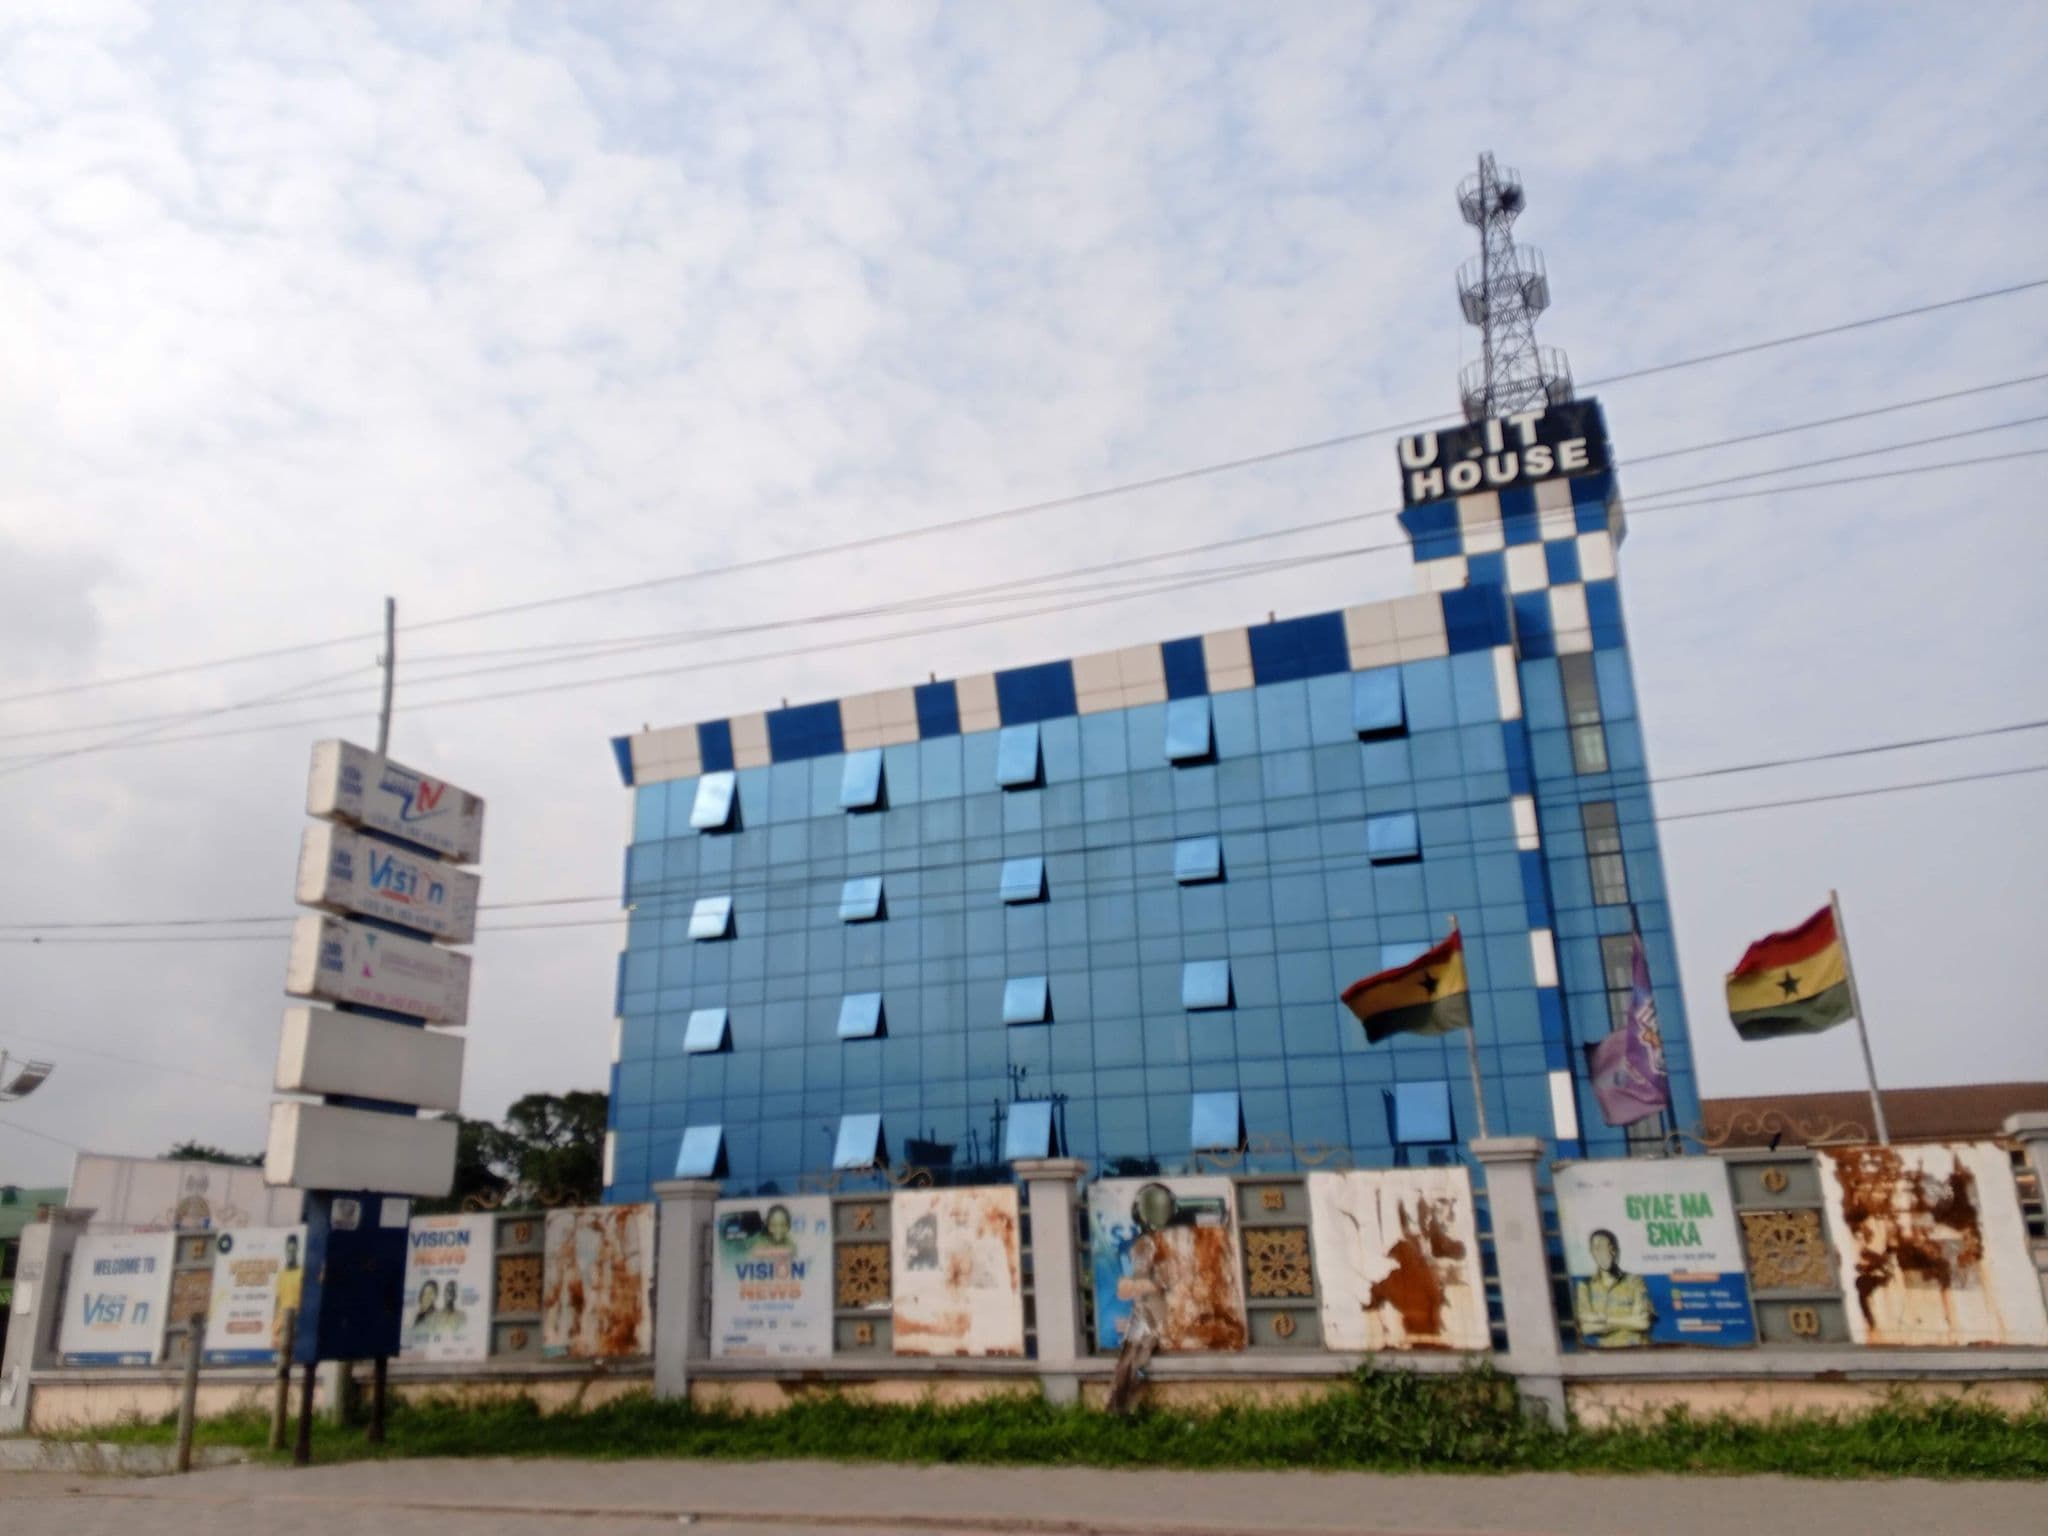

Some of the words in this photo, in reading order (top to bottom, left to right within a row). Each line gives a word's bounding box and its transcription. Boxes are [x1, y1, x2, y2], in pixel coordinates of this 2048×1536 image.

[1400, 408, 1545, 468] UIT
[1411, 437, 1590, 501] HOUSE
[409, 1230, 471, 1248] VISION
[93, 1257, 141, 1276] WELCOME
[735, 1260, 806, 1281] VISION
[83, 1293, 150, 1327] Visin
